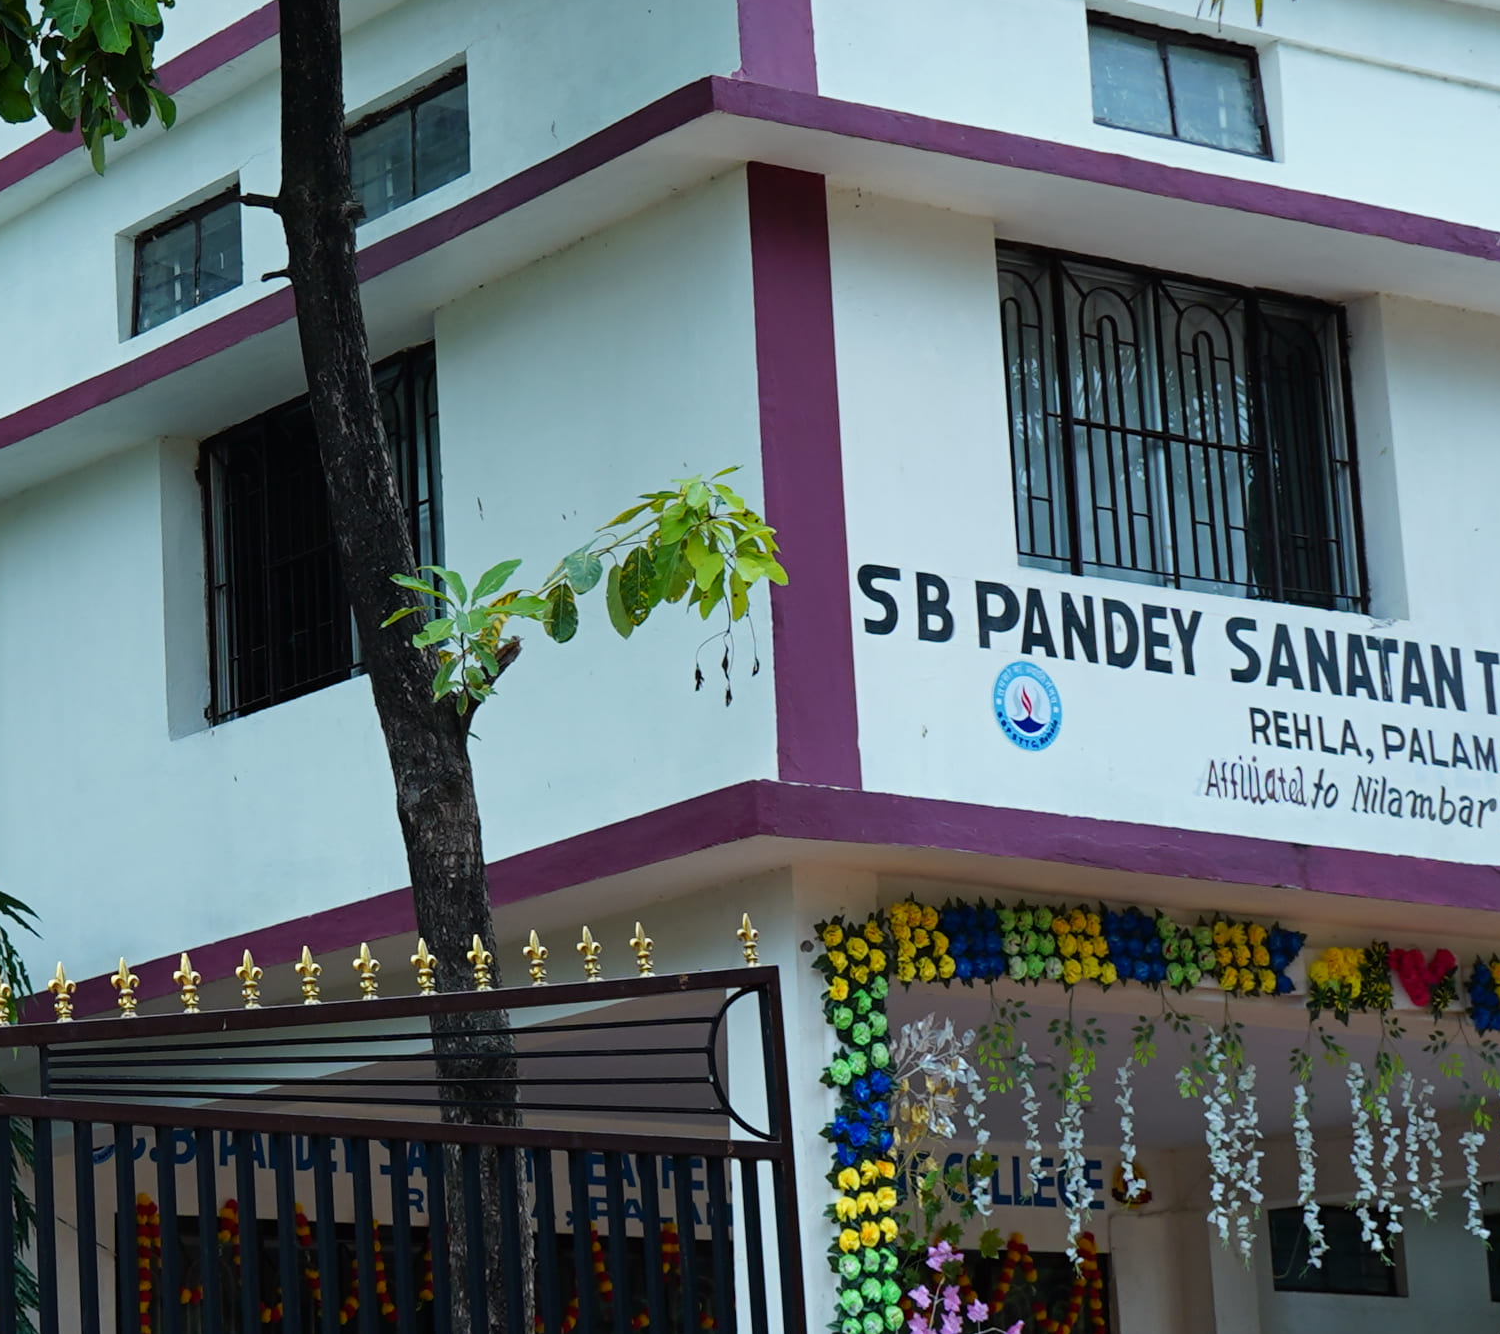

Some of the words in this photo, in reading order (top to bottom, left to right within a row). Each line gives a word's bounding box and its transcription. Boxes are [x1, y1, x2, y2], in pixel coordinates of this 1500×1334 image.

[975, 580, 1203, 676] PANDEY
[1225, 616, 1467, 715] SANATAN
[1249, 706, 1375, 764] REHLA,
[1311, 768, 1339, 809] to
[1351, 775, 1497, 829] Nilambar
